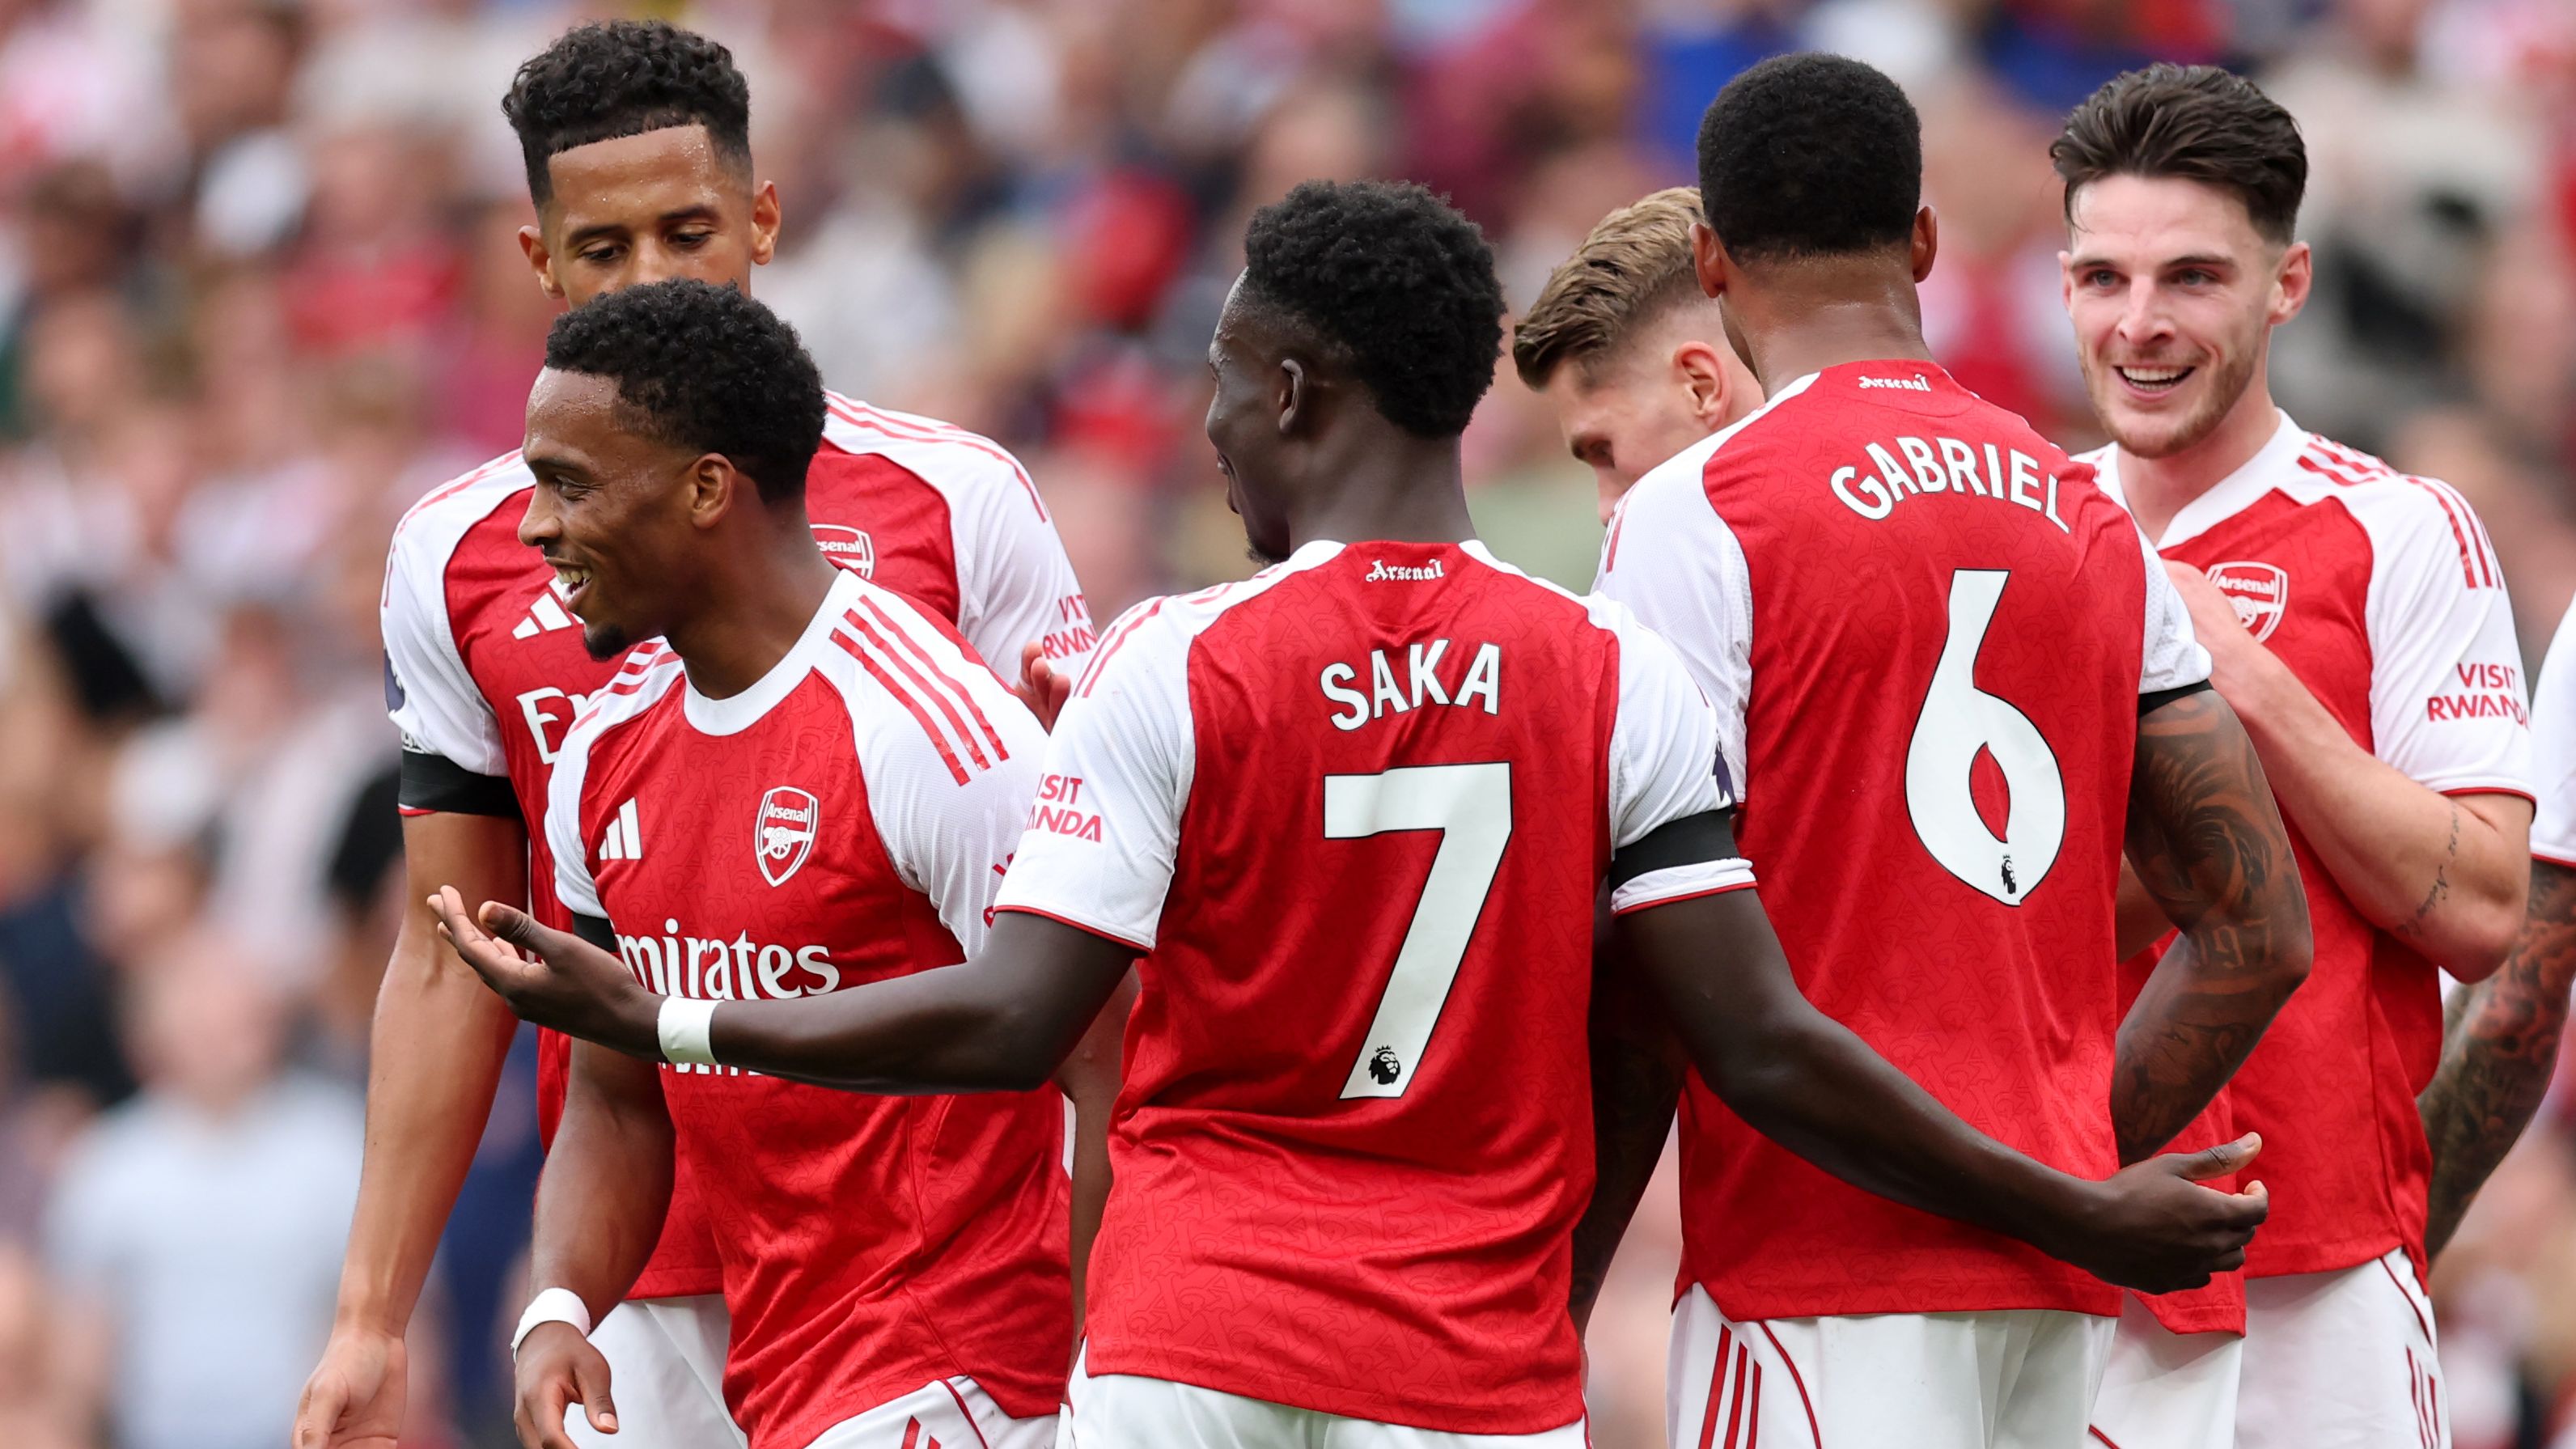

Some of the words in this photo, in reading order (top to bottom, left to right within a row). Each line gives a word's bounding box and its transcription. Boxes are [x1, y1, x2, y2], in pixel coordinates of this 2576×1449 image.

[1858, 373, 1932, 392] Arsenal
[1830, 436, 2070, 535] GABRIEL
[1365, 558, 1445, 583] Arsenal
[2216, 575, 2274, 595] Arsenal
[1320, 638, 1501, 731] SAKA
[2457, 663, 2516, 694] VISIT
[1904, 568, 2066, 907] 6
[765, 803, 808, 823] Arsenal
[612, 917, 841, 1001] mirates
[1324, 761, 1513, 1100] 7
